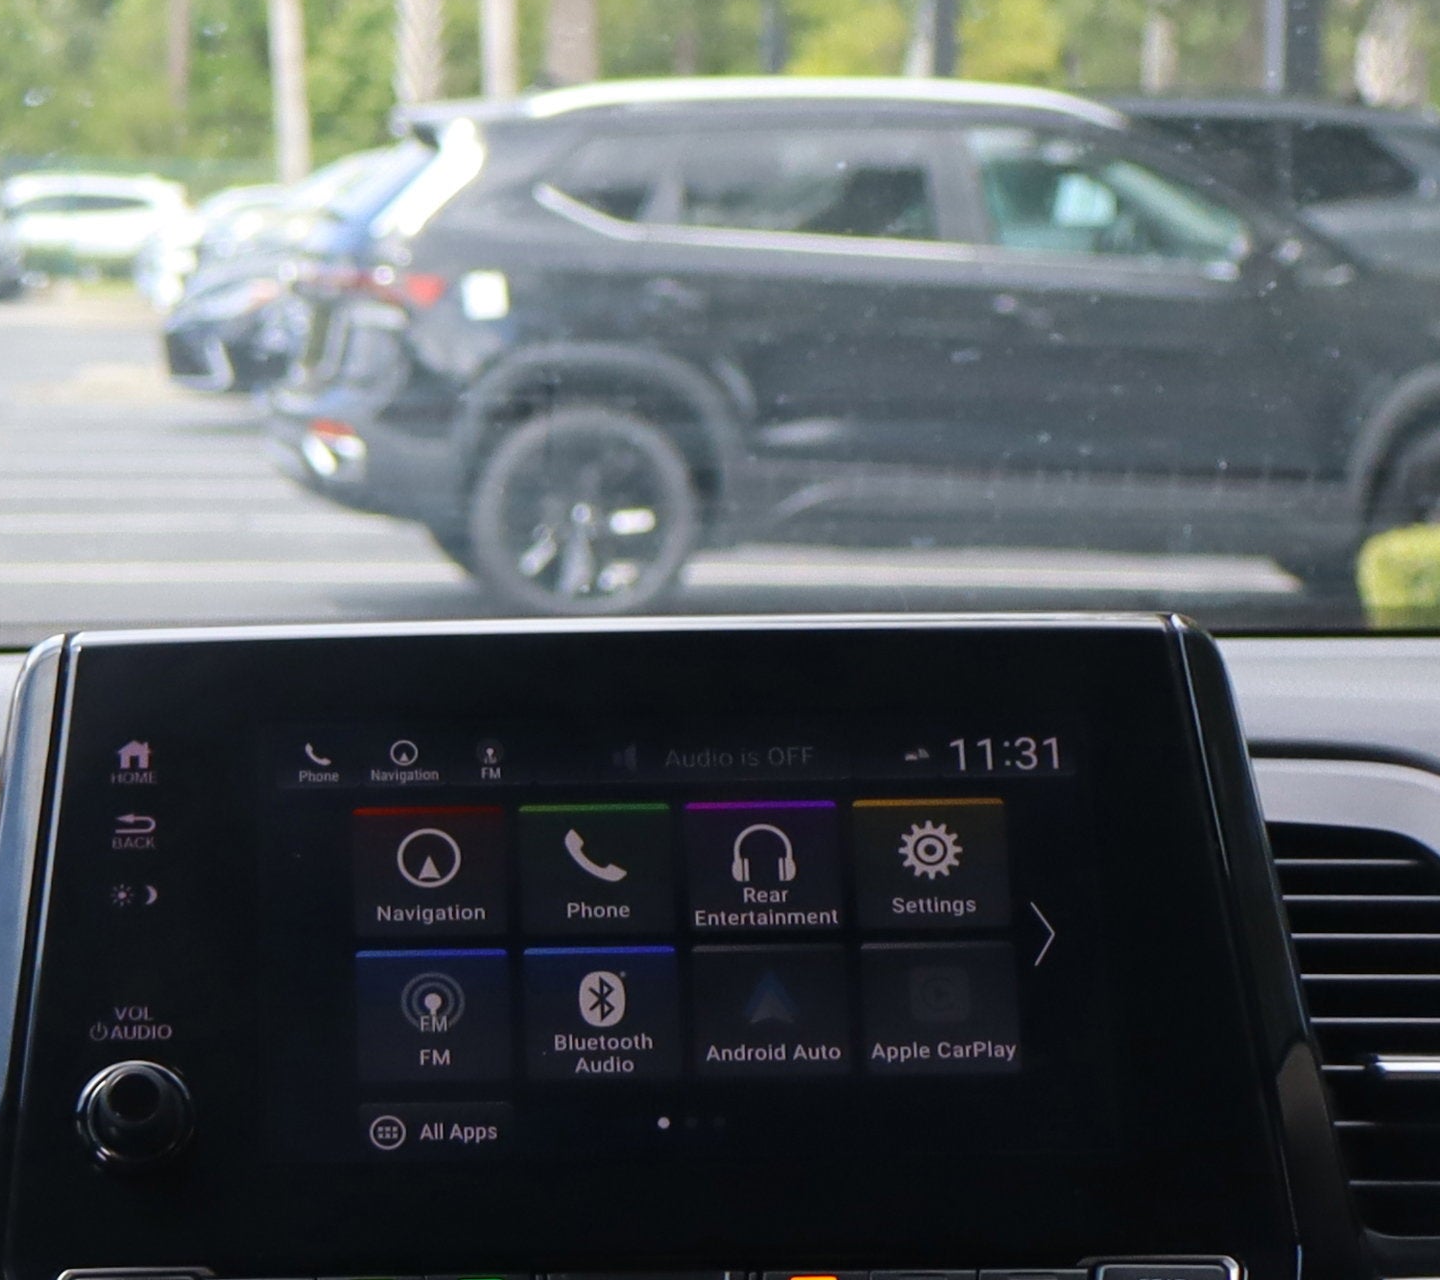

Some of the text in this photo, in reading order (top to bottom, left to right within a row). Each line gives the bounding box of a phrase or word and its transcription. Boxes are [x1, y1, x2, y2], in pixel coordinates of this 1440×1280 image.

[664, 745, 815, 768] Audio is OFF
[948, 736, 1062, 772] 11:31
[110, 770, 158, 785] HOME
[298, 768, 340, 784] Phone
[370, 767, 440, 784] Navigation
[480, 766, 502, 780] FM
[111, 835, 156, 850] BACK
[742, 885, 789, 904] Rear
[376, 903, 486, 925] Navigation
[566, 901, 631, 919] Phone
[891, 895, 977, 917] Settings
[694, 906, 839, 927] Entertainment
[114, 1005, 154, 1020] VOL
[110, 1023, 172, 1040] AUDIO
[554, 1032, 654, 1052] Bluetooth
[419, 1049, 451, 1066] FM
[706, 1042, 842, 1062] Android Auto
[871, 1040, 1018, 1064] Apple CarPlay
[574, 1054, 635, 1074] Audio
[419, 1122, 498, 1144] All Apps
